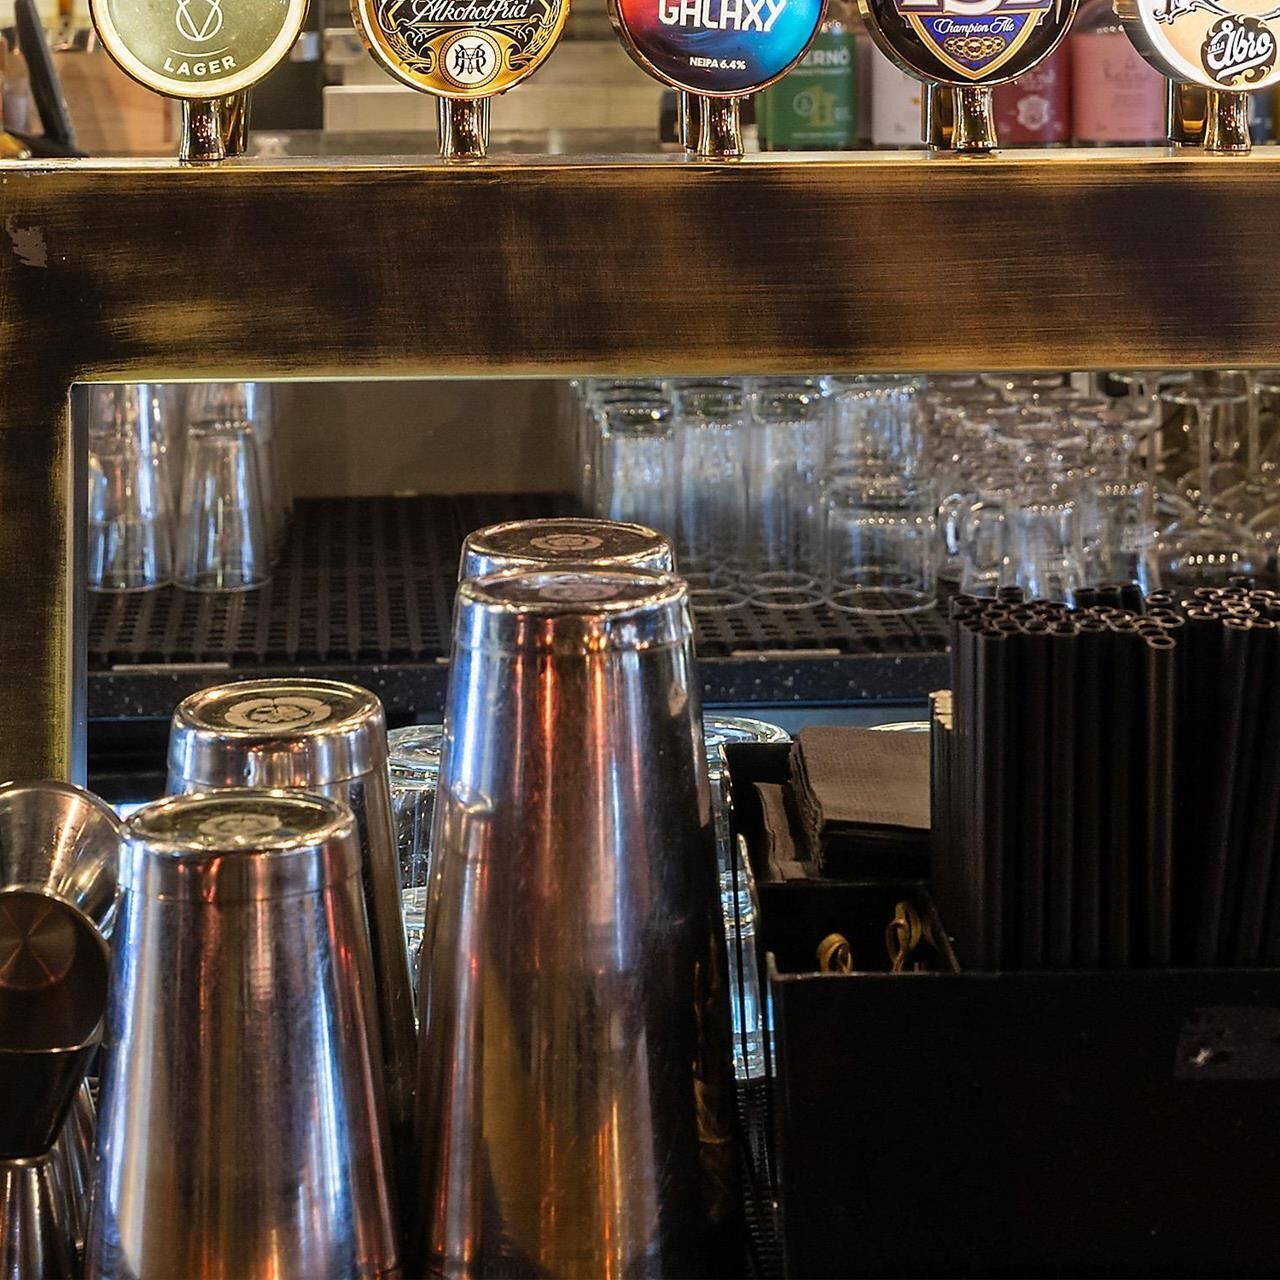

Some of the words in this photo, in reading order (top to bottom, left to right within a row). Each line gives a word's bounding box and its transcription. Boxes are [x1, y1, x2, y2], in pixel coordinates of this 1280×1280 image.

[933, 17, 990, 37] Champion
[989, 15, 1015, 34] Ale
[1207, 20, 1273, 70] Åbro
[162, 55, 237, 76] LAGER
[689, 56, 719, 69] NEIPA
[719, 58, 747, 70] 6.4%
